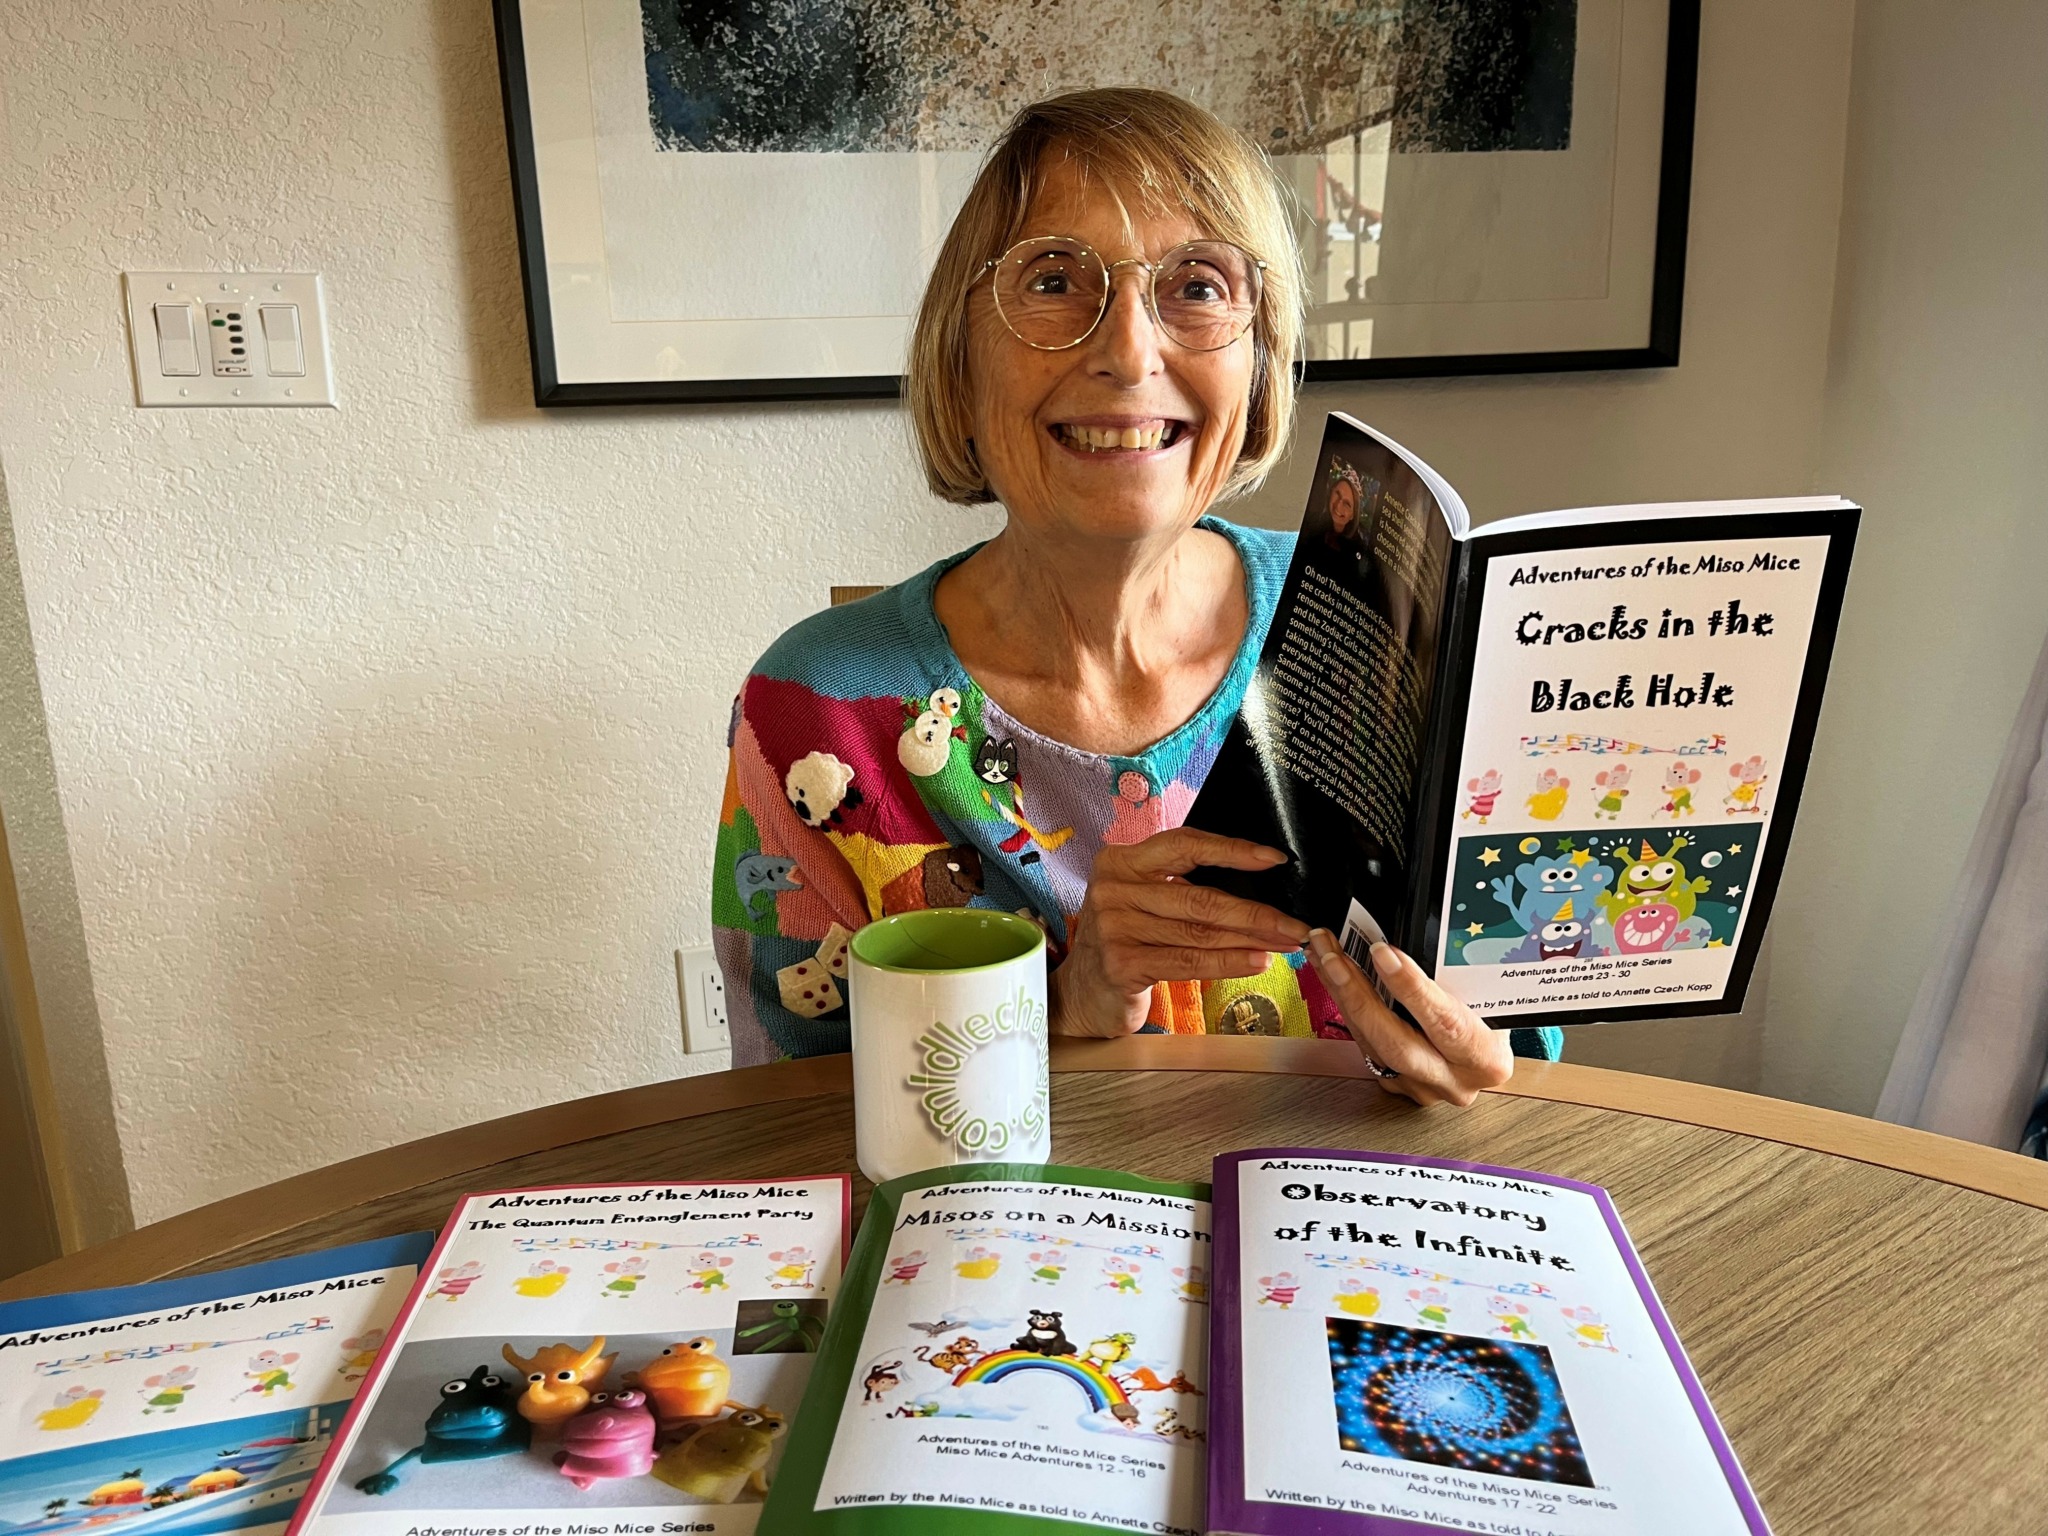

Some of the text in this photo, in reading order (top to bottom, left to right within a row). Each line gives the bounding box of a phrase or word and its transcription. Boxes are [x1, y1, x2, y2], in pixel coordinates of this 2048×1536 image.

[1509, 552, 1801, 587] Adventures of the Miso Mice
[1301, 580, 1374, 635] see cracks in Mu's black
[1305, 565, 1379, 623] Oh no! The Intergalactic
[1289, 617, 1332, 649] something's
[1293, 605, 1359, 653] and the Zodiac Girls
[1297, 592, 1370, 646] renowned orange slice
[1515, 599, 1774, 646] Cracks in the
[1281, 642, 1325, 673] everywhere
[1285, 629, 1309, 651] taking
[1309, 642, 1322, 658] but
[1322, 653, 1344, 674] giving
[1273, 664, 1304, 690] become
[1309, 686, 1332, 709] lemon
[1332, 704, 1352, 723] grove
[1277, 653, 1317, 684] Sandman's
[1316, 676, 1341, 700] Lemon
[1530, 672, 1735, 713] Black Hole
[1268, 676, 1343, 732] lemons are flung out
[1303, 711, 1324, 732] You'll
[1323, 728, 1344, 746] never
[1292, 736, 1321, 759] mouse?
[1321, 753, 1341, 775] Enjoy
[1341, 768, 1353, 783] the
[1335, 796, 1369, 827] acclaimed
[1337, 780, 1369, 813] Miso Mice
[1501, 957, 1672, 979] Adventures of the Miso Mice Series
[1538, 970, 1631, 985] Adventures 23 30
[1484, 1001, 1496, 1009] by
[1498, 999, 1514, 1007] the
[1516, 996, 1540, 1005] Miso
[1542, 993, 1565, 1003] Mice
[1581, 990, 1599, 999] told
[1601, 990, 1612, 998] to
[1613, 987, 1651, 997] Annette
[1653, 985, 1684, 994] Czech
[1687, 983, 1713, 994] Kopp
[1260, 1160, 1554, 1197] Adventures of the Miso Mice
[488, 1186, 809, 1209] Adventures of the Miso Mice
[920, 1185, 1196, 1212] Adventures of the Miso Mice
[1281, 1183, 1548, 1232] Observatory
[468, 1208, 814, 1232] The Quantum Entanglement Party
[895, 1209, 1211, 1243] Misos on a Mission
[1273, 1221, 1576, 1272] of the Infinite
[0, 1276, 385, 1351] Adventures of the Miso Mice
[917, 1434, 1166, 1471] Adventures of the Miso Mice Series
[937, 1445, 1146, 1478] Miso Mice Adventures 12 16
[1341, 1459, 1618, 1510] Adventures of the Miso Mice Series
[1406, 1482, 1558, 1515] Adventures 17 22
[406, 1521, 715, 1536] Adventures of the Miso Mice Series
[834, 1492, 1199, 1536] Written by the Miso Mice as told to Annette Czech
[1265, 1488, 1541, 1536] Written by the Miso Mice as told to
